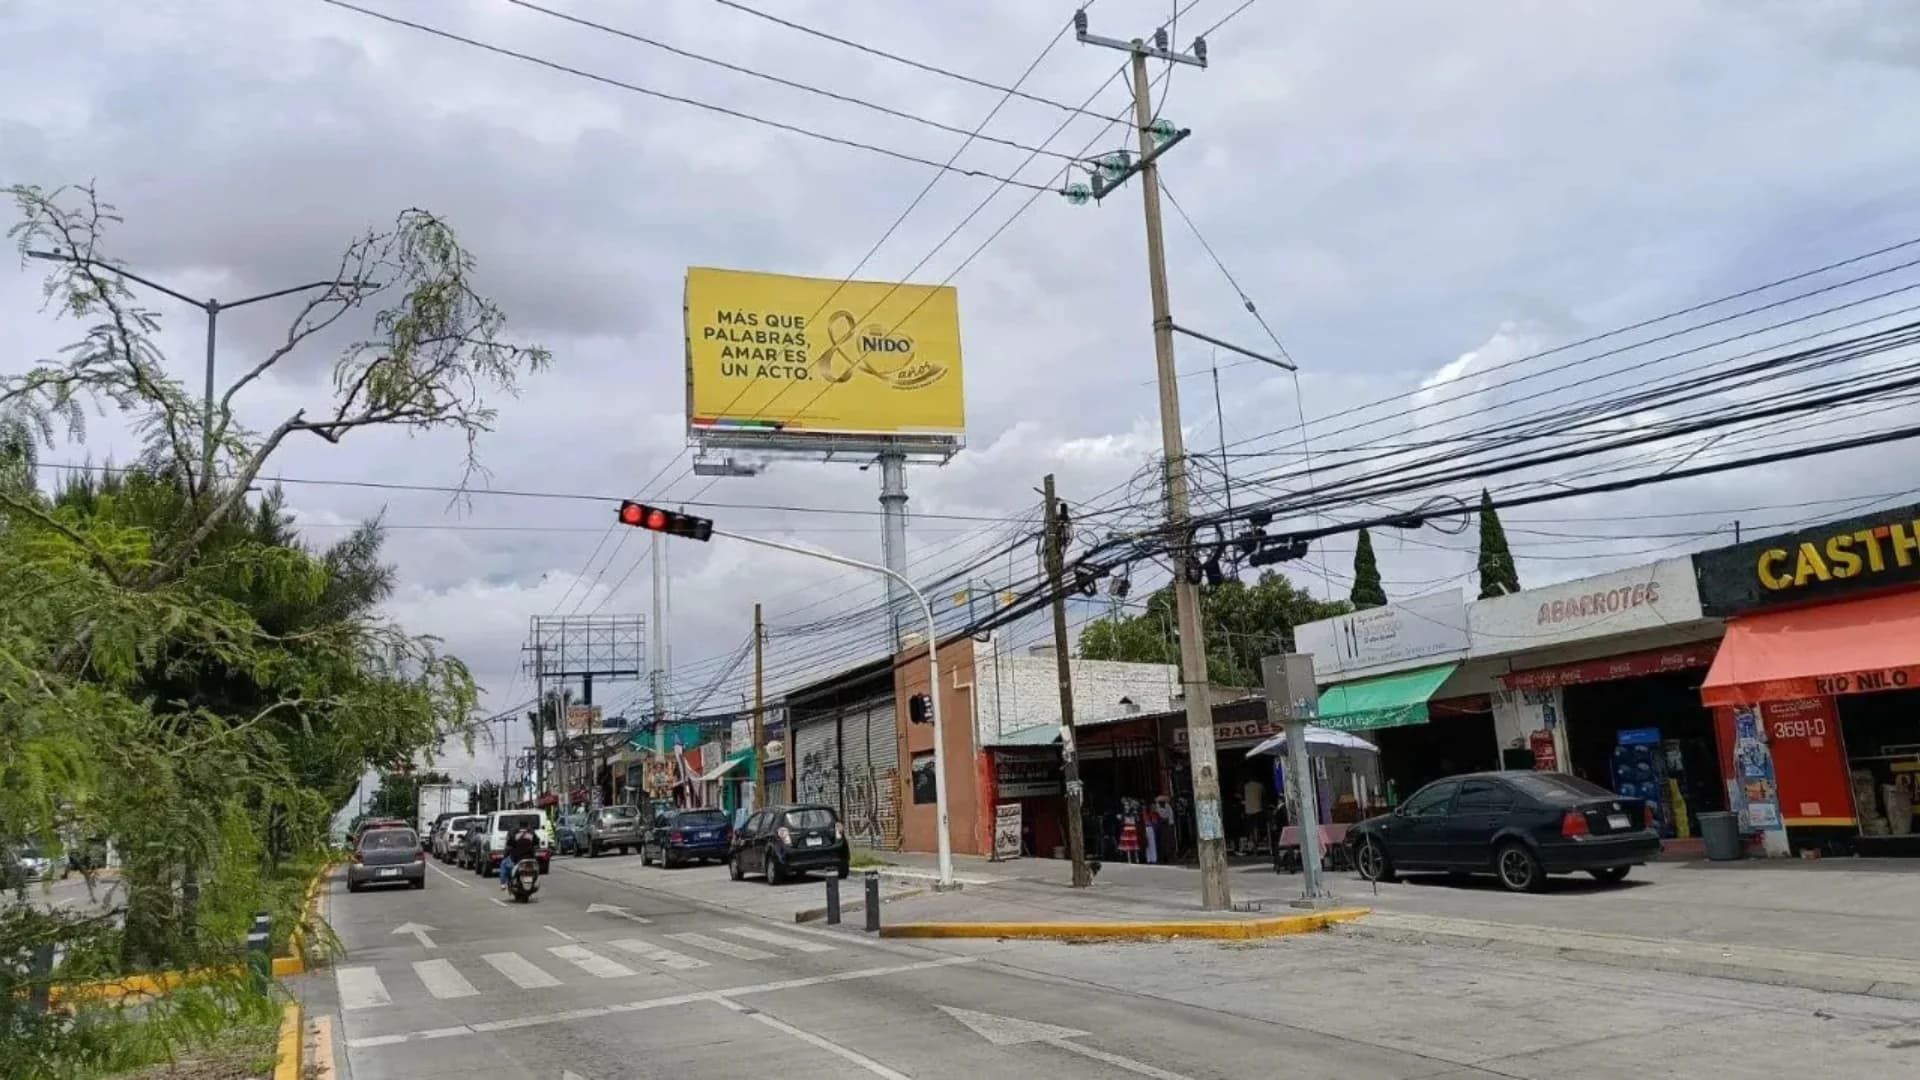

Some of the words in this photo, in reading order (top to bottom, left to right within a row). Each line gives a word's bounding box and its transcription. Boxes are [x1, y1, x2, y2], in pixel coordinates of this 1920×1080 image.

[717, 308, 758, 326] MÁS
[765, 314, 805, 329] QUE
[703, 326, 811, 349] PALABRAS,
[862, 335, 911, 353] NIDO
[721, 346, 778, 361] AMAR
[784, 349, 807, 363] ES
[721, 362, 748, 377] UN
[756, 365, 813, 380] ACTO.
[1537, 581, 1660, 625] ABARROTES
[1856, 670, 1909, 690] NILO
